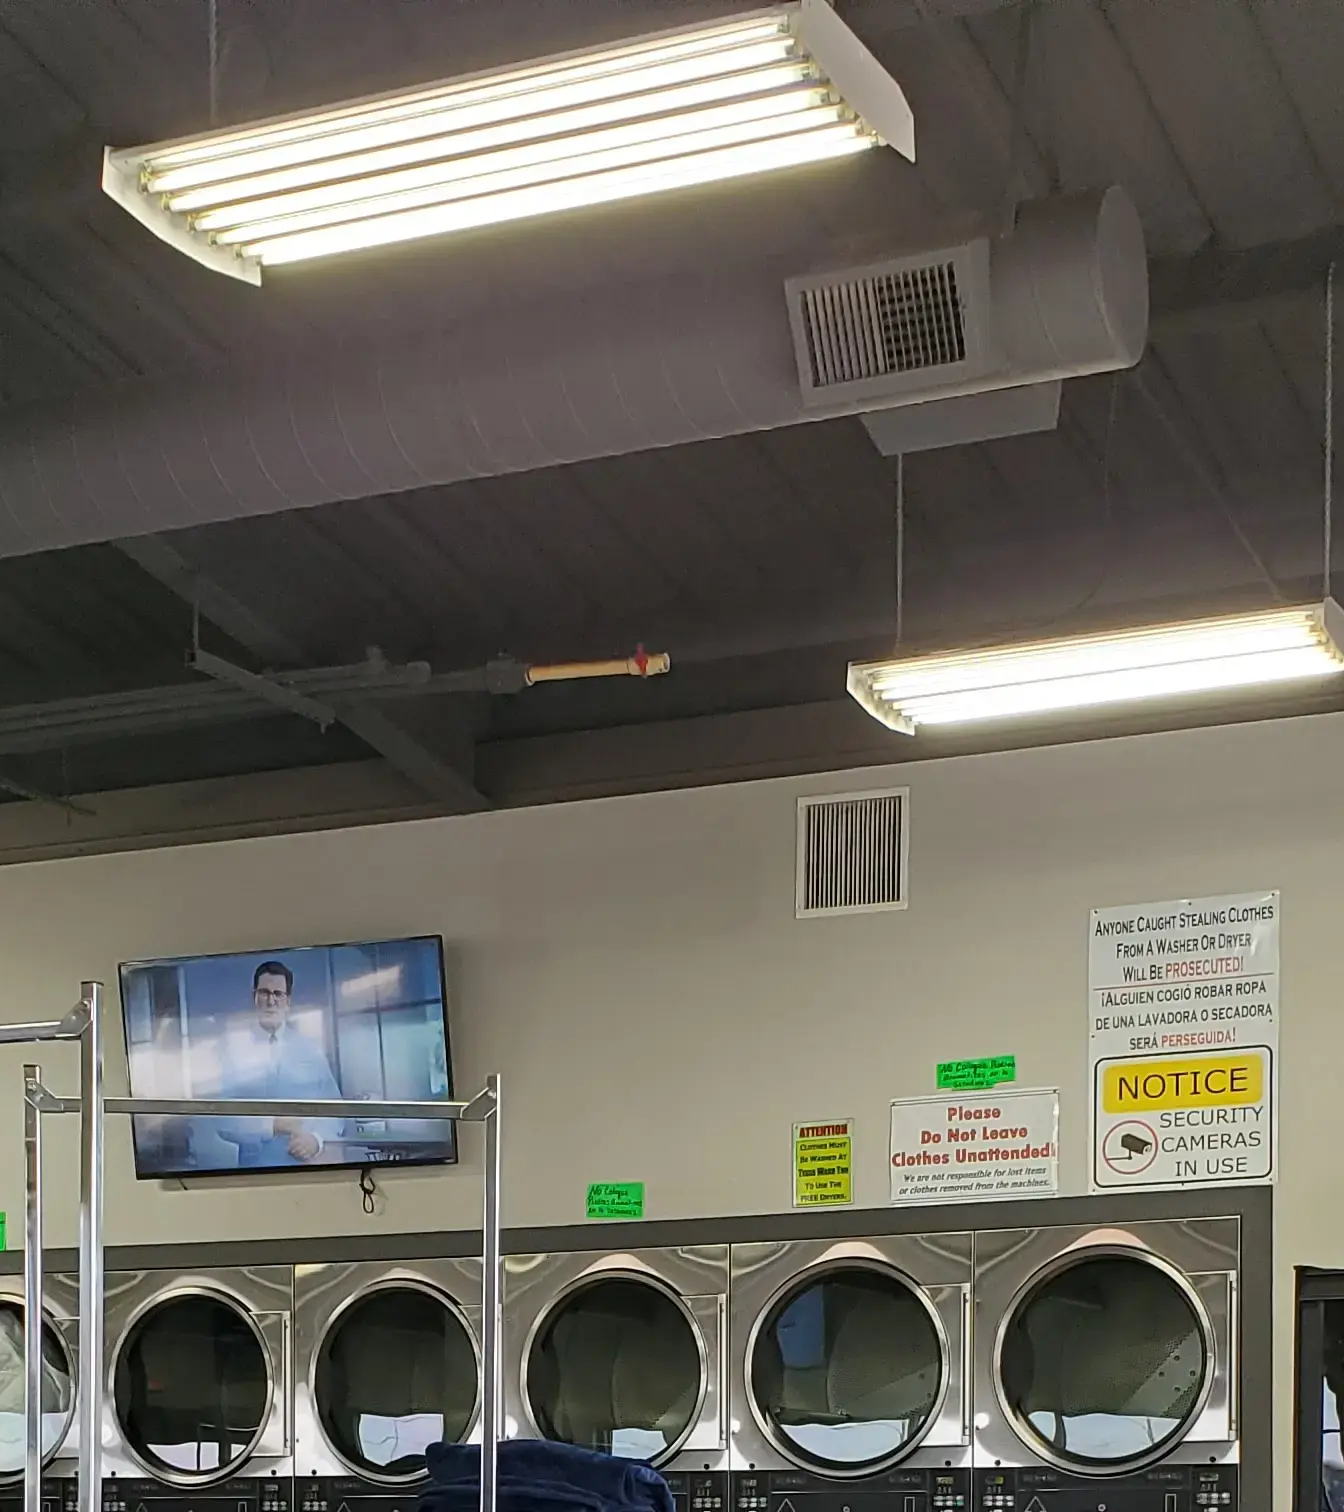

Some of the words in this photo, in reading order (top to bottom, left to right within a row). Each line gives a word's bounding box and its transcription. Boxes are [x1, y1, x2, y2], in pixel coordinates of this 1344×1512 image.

[1146, 940, 1153, 956] A
[1165, 956, 1244, 979] PROSECUTED!
[1194, 983, 1232, 1000] ROBAR
[1235, 980, 1267, 996] ROPA
[1096, 1017, 1110, 1031] DE
[1112, 1015, 1135, 1029] UNA
[1138, 1010, 1198, 1027] LAVADORA
[1200, 1009, 1208, 1021] O
[1211, 1003, 1273, 1021] SECADORA
[1129, 1033, 1158, 1050] SERÁ
[1161, 1027, 1236, 1048] PERSEGUIDA!
[1118, 1067, 1248, 1101] NOTICE
[947, 1105, 1001, 1122] Please
[1159, 1105, 1264, 1129] SECURITY
[920, 1130, 941, 1144] Do
[947, 1127, 976, 1143] Not
[982, 1126, 1028, 1141] Leave
[1161, 1131, 1261, 1153] CAMERAS
[892, 1151, 949, 1167] Clothes
[955, 1142, 1056, 1163] Unattended!
[903, 1174, 915, 1183] We
[917, 1174, 929, 1182] are
[931, 1173, 945, 1181] not
[946, 1167, 992, 1181] responsible
[993, 1167, 1006, 1177] for
[1007, 1167, 1022, 1176] lost
[1175, 1160, 1197, 1176] IN
[1206, 1156, 1248, 1175] USE
[899, 1187, 908, 1195] or
[909, 1184, 938, 1194] clothes
[939, 1183, 973, 1193] removed
[975, 1182, 994, 1191] from
[996, 1180, 1009, 1189] the
